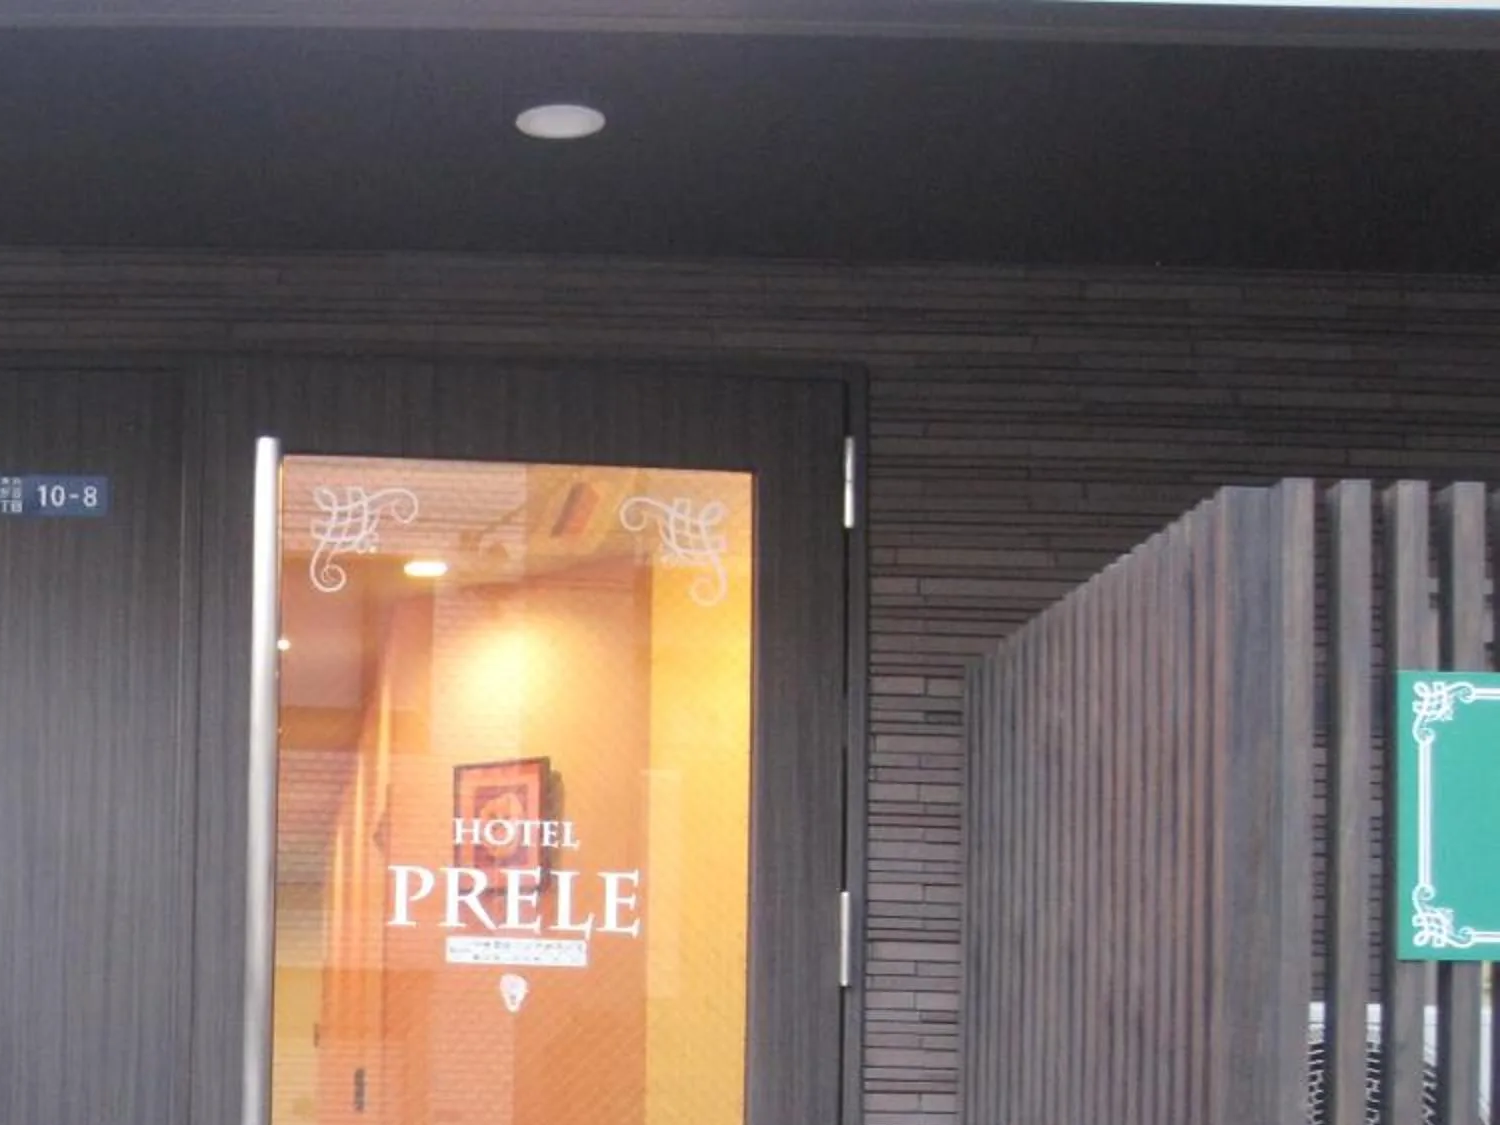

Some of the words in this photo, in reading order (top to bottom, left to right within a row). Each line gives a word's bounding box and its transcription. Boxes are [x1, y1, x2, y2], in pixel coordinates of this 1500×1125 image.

[37, 484, 98, 508] 10-8
[453, 817, 580, 849] HOTEL
[387, 864, 641, 940] PRELE
